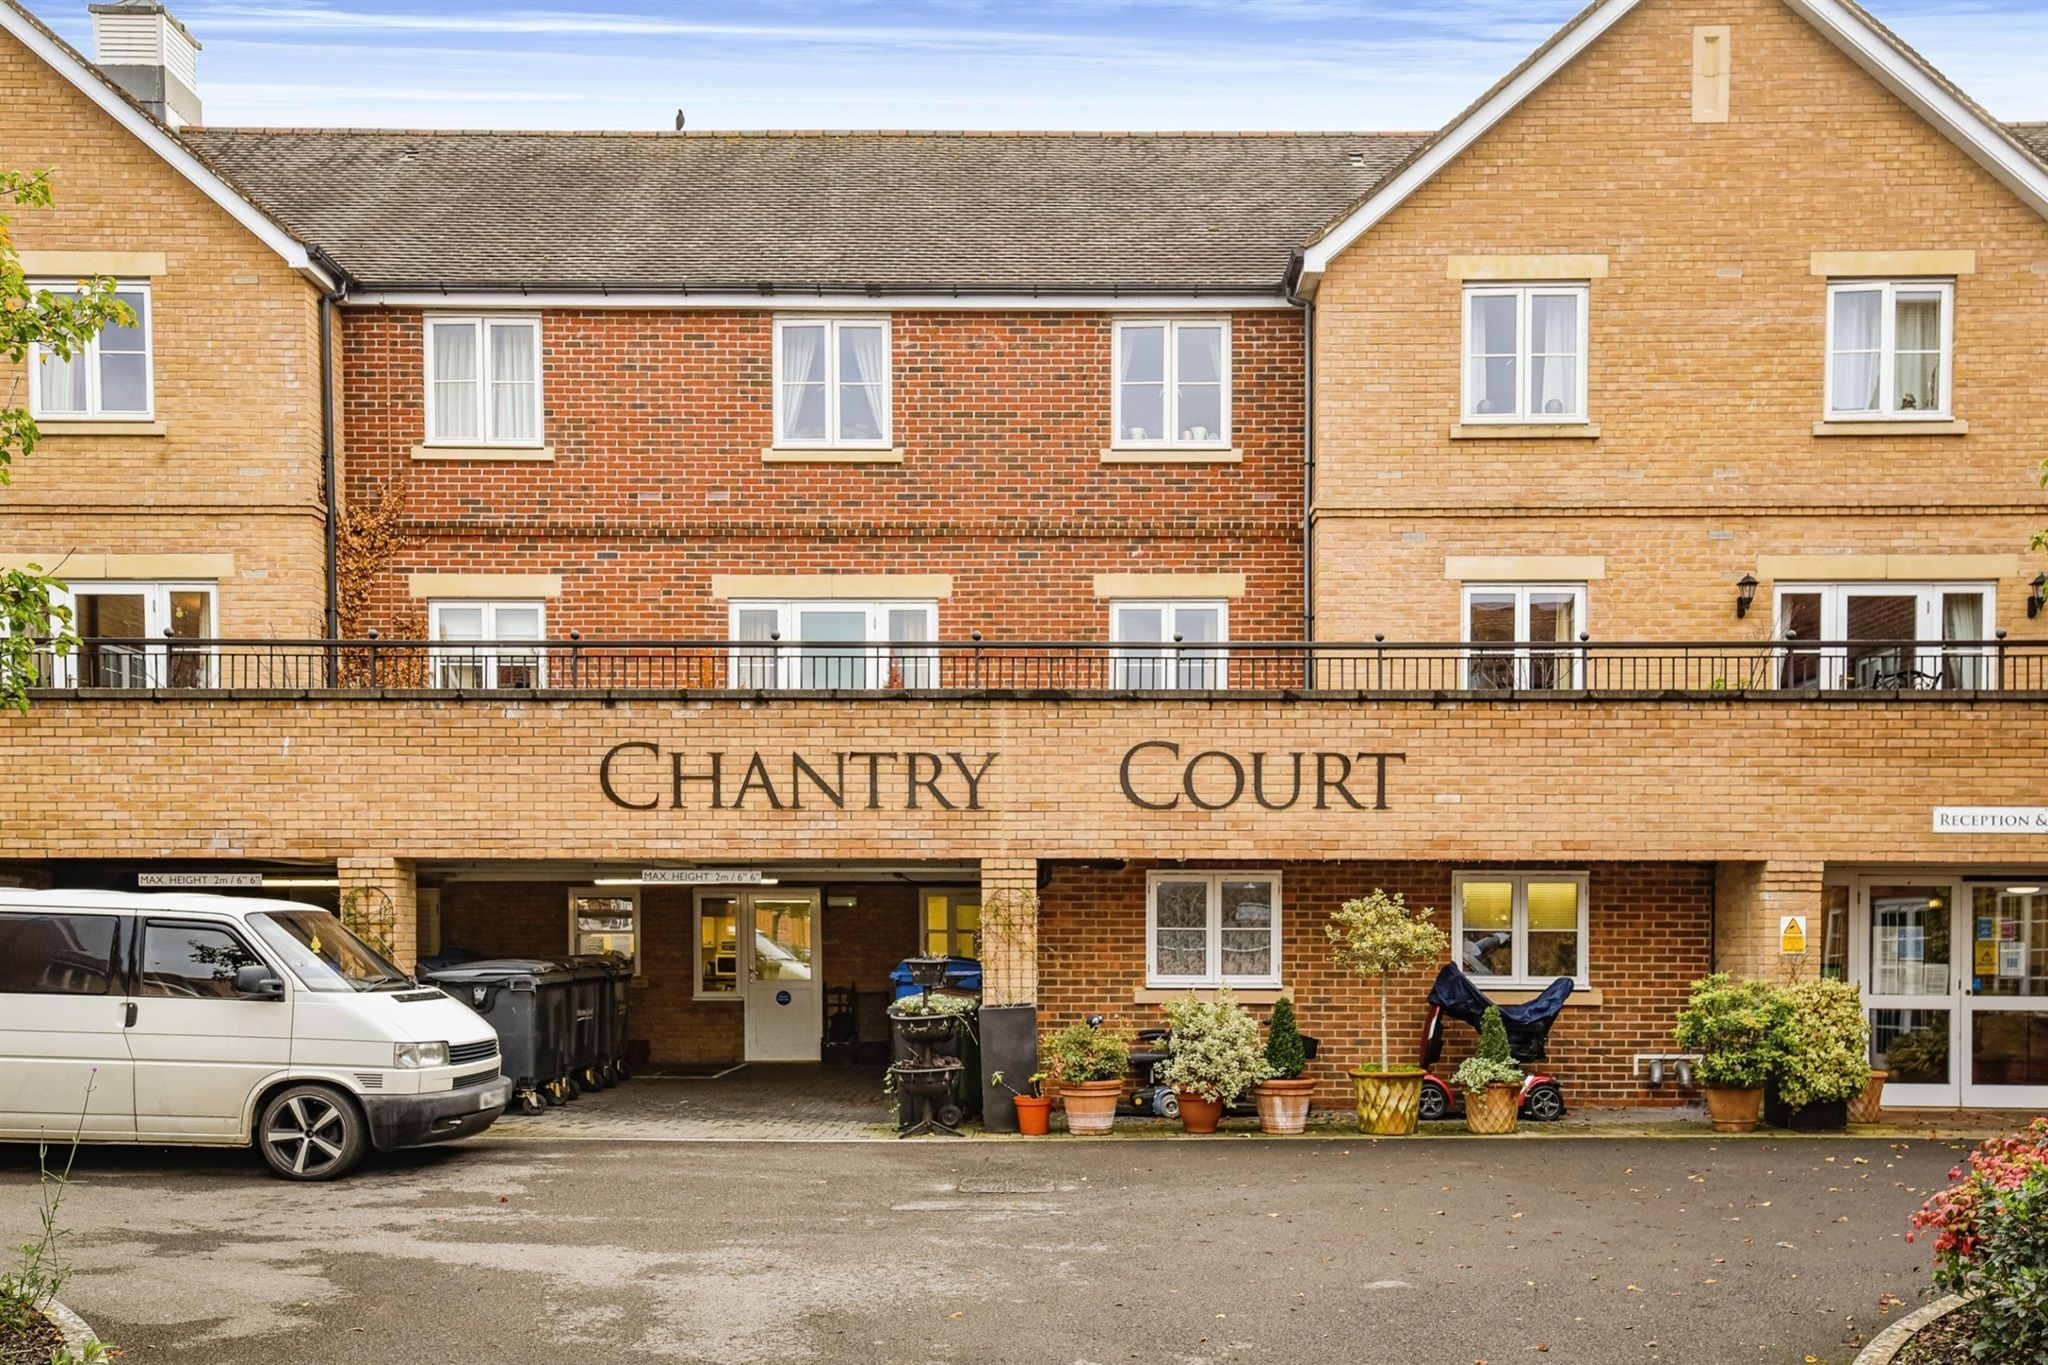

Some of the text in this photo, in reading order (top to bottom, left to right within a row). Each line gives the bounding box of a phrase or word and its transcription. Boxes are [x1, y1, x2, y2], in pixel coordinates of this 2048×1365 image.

[600, 741, 1406, 810] CHANTRY COURT
[1940, 813, 2048, 826] RECEPTION &
[140, 876, 167, 885] MAX.
[169, 876, 208, 884] HEIGHT
[214, 876, 228, 884] 2m
[643, 872, 669, 881] MAX.
[672, 872, 710, 881] HEIGHT
[715, 873, 729, 881] 2m
